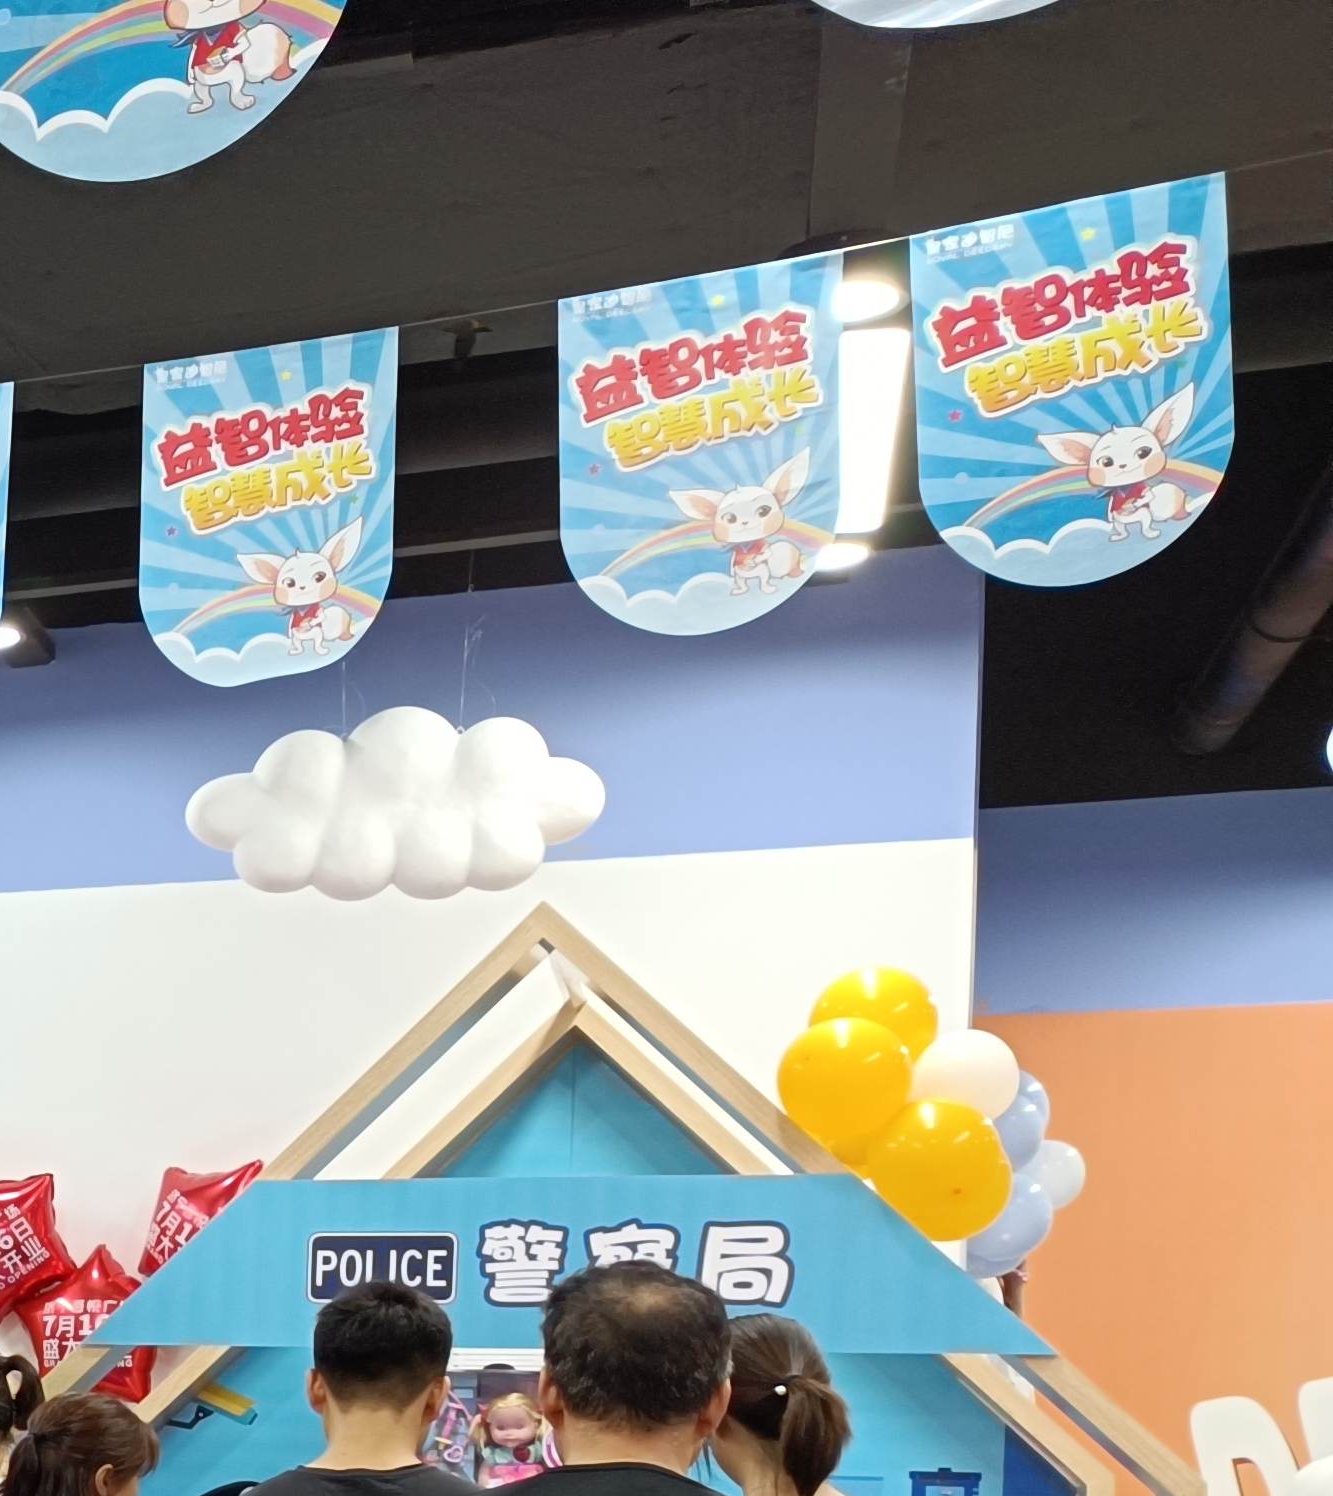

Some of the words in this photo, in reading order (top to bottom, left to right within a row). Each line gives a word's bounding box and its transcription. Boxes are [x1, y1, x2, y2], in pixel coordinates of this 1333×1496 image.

[933, 243, 1190, 367] 益智体验
[577, 312, 807, 422] 益智体验
[967, 301, 1202, 413] 智慧成长
[158, 388, 364, 487] 益智体验
[607, 368, 817, 468] 智慧成长
[184, 442, 372, 531] 智慧成长
[315, 1248, 449, 1288] POLICE
